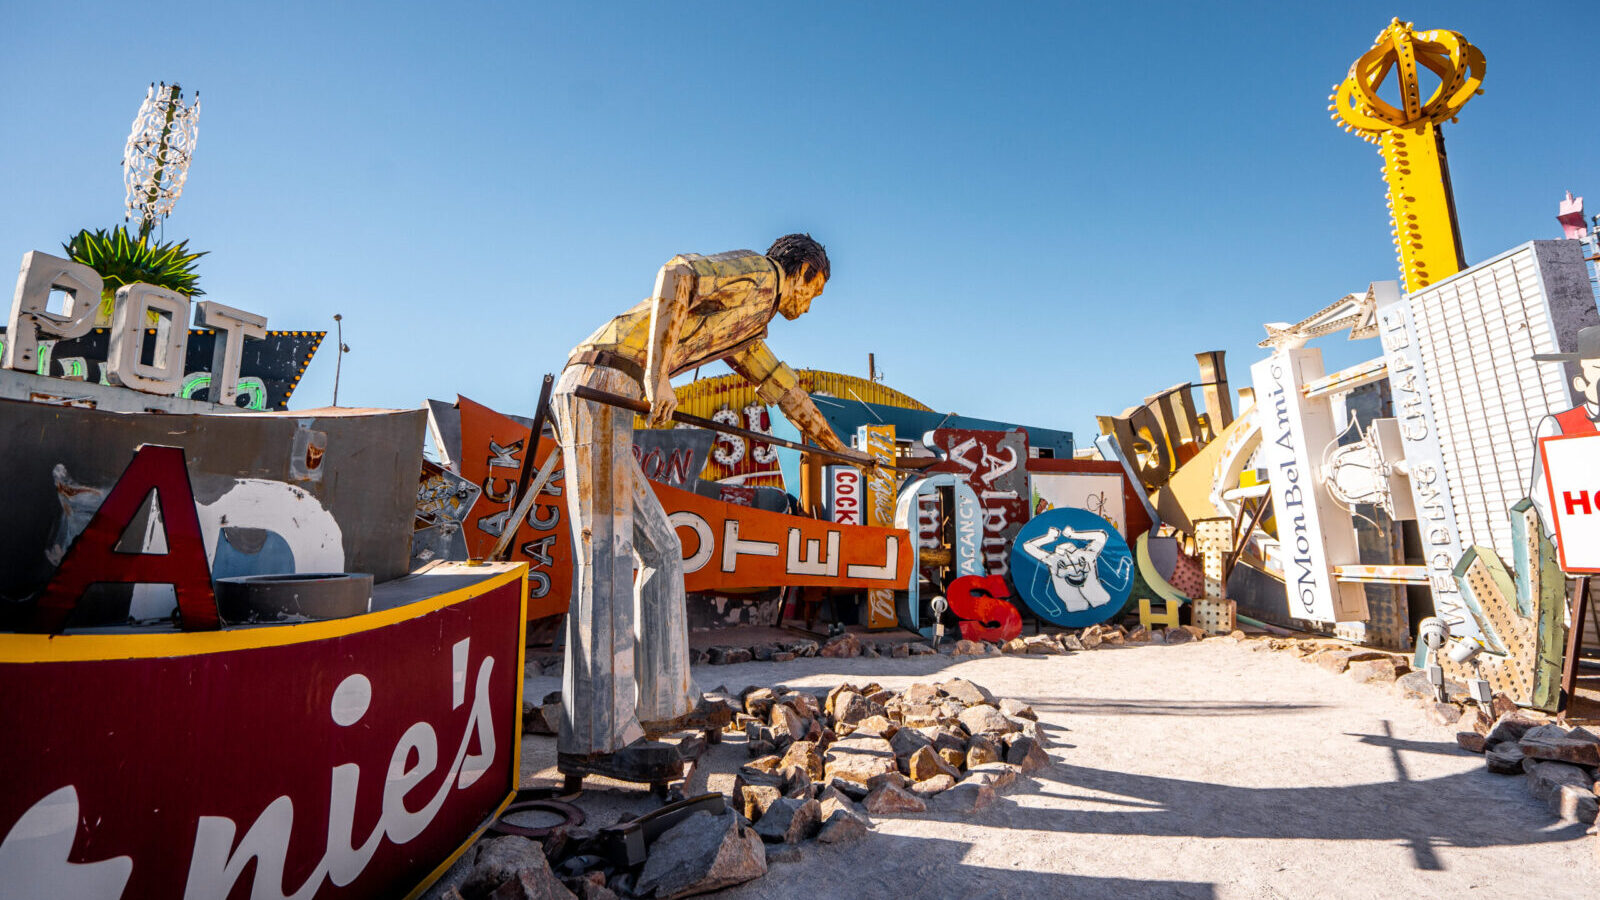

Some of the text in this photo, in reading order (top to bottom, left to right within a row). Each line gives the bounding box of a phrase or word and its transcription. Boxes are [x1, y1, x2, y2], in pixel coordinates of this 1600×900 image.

[2, 250, 268, 407] POT
[36, 443, 222, 635] A
[521, 466, 565, 599] JACK
[836, 471, 859, 525] COCK
[1267, 364, 1318, 614] Mon Bel Ami
[1382, 306, 1466, 628] WEDDING CHAPEL
[1563, 490, 1600, 515] H
[946, 574, 1023, 643] S
